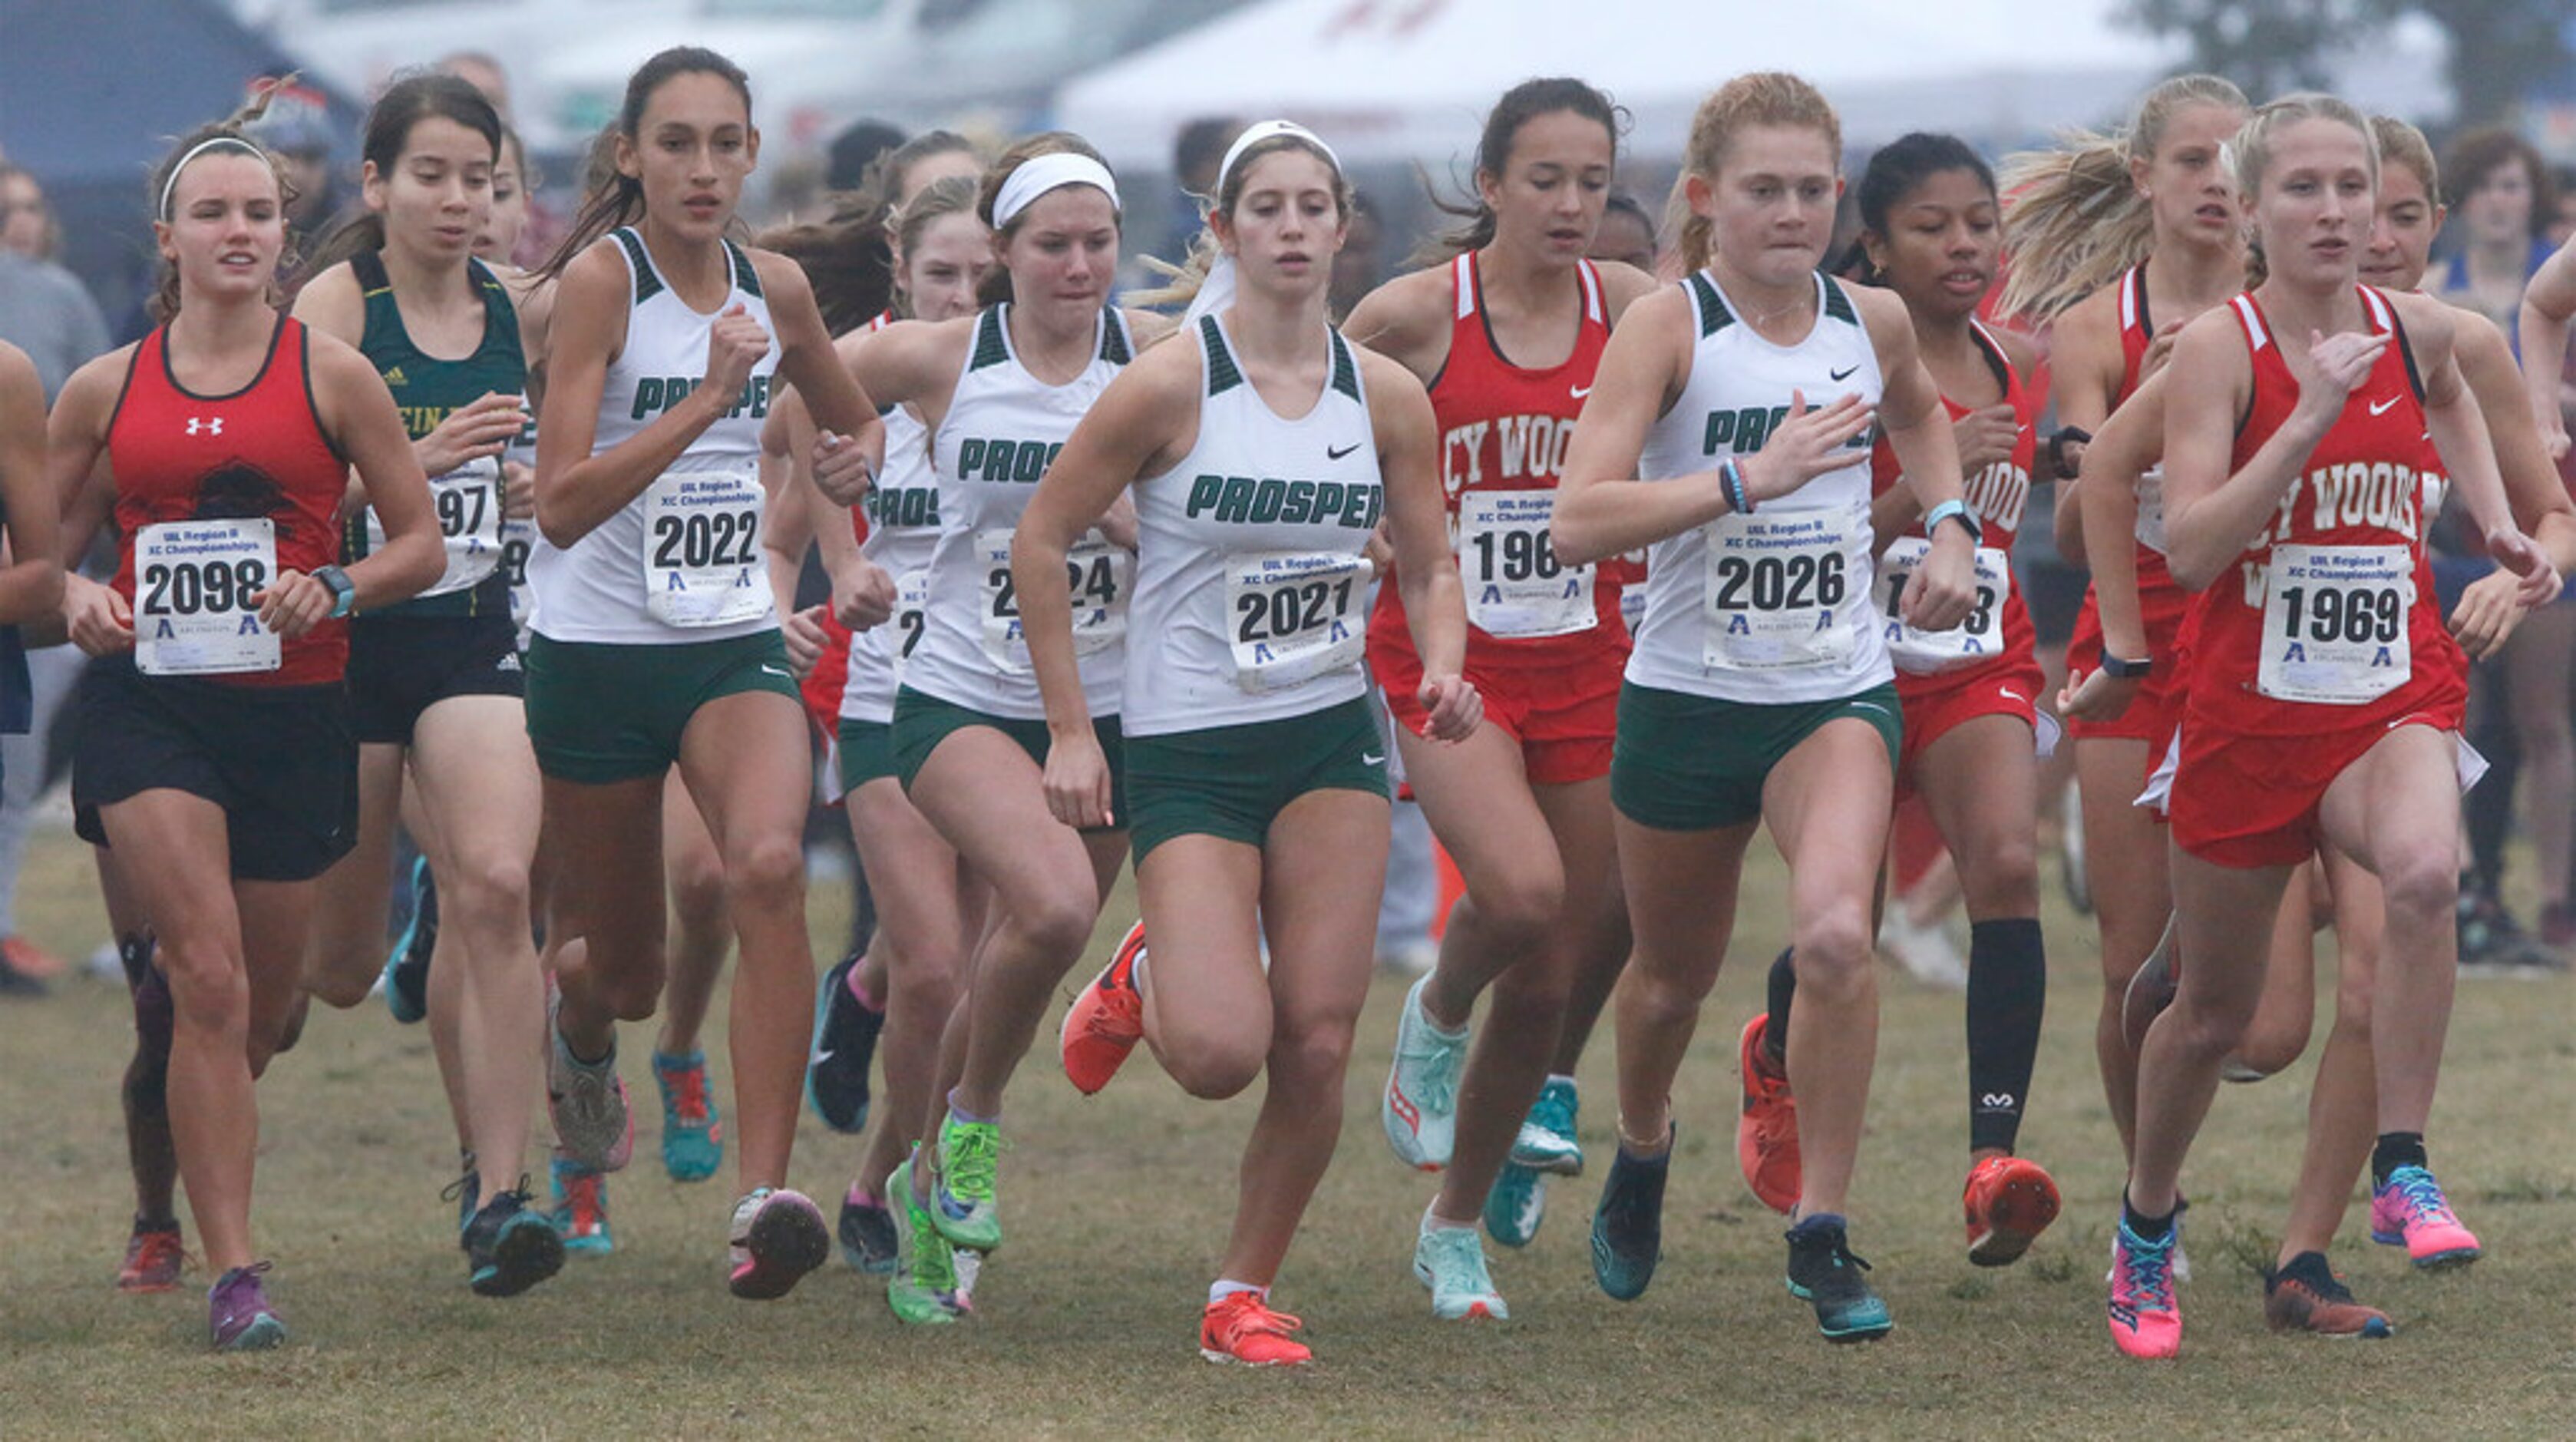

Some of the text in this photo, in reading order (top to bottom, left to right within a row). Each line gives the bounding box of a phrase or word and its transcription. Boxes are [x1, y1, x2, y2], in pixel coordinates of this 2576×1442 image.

[1445, 415, 1577, 493] CY WOO
[662, 493, 757, 506] XC Championships
[699, 481, 733, 493] Region
[1187, 475, 1382, 529] PROSPER
[438, 485, 487, 538] 97
[1477, 512, 1551, 523] XC Champio
[1519, 500, 1553, 511] Regio
[183, 531, 226, 542] Region
[654, 511, 758, 569] 2022
[1725, 534, 1842, 548] XC Championships
[1771, 522, 1811, 534] Region
[149, 541, 259, 555] XC Championships
[1474, 528, 1585, 581] 196
[2332, 556, 2375, 568] Region
[144, 558, 266, 615] 2098
[989, 556, 1117, 617] 224
[1243, 575, 1260, 585] XC
[1716, 551, 1844, 610] 2026
[2288, 567, 2306, 577] XC
[1237, 577, 1352, 643] 2021
[1886, 573, 1996, 636] 13
[2281, 586, 2400, 643] 1969
